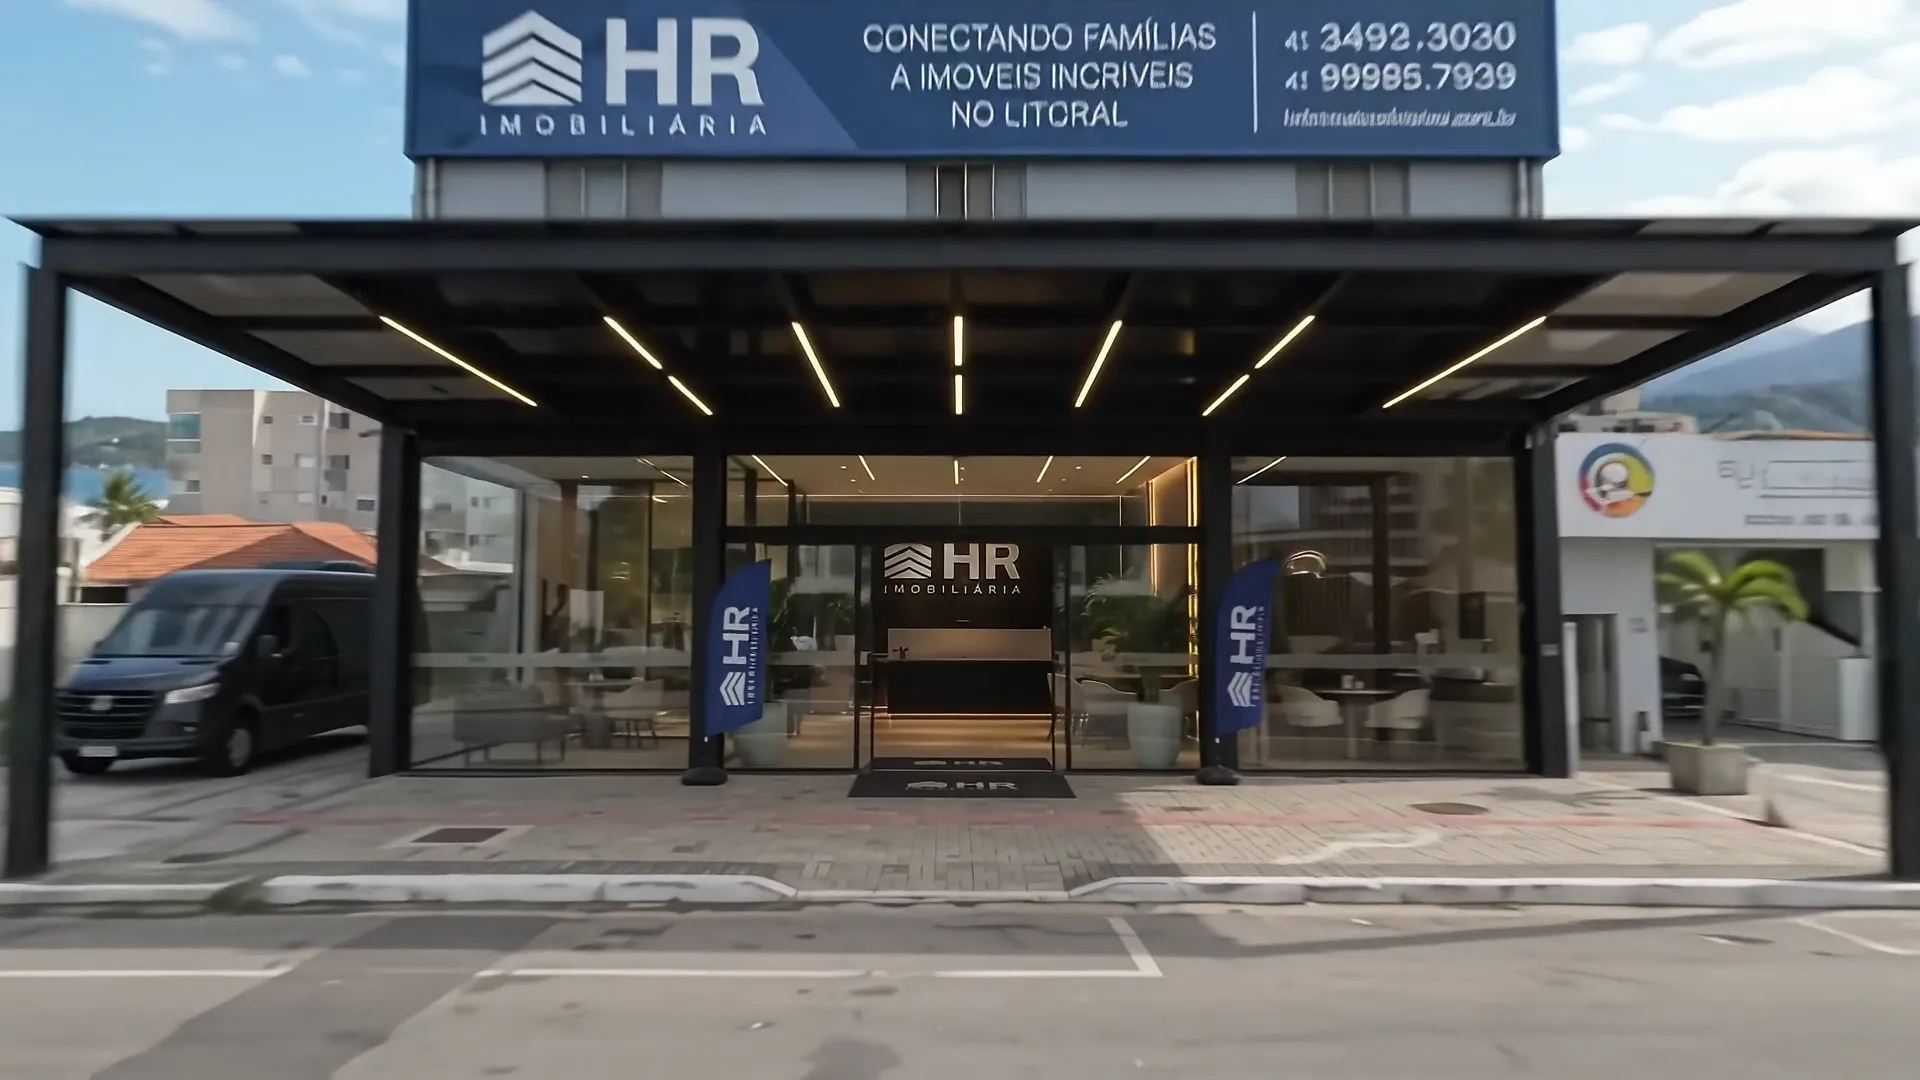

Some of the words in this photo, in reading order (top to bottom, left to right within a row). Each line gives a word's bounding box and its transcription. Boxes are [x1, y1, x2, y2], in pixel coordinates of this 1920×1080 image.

[863, 22, 1073, 53] CONECTANDO
[1083, 16, 1217, 52] FAMÍLIAS
[606, 18, 764, 106] HR
[890, 62, 911, 91] A
[951, 100, 994, 129] NO
[1004, 100, 1128, 128] LITORAL
[943, 543, 1021, 580] HR
[884, 583, 1021, 594] IMOBILIÁRIA
[722, 606, 750, 665] HR
[1230, 605, 1256, 664] HR
